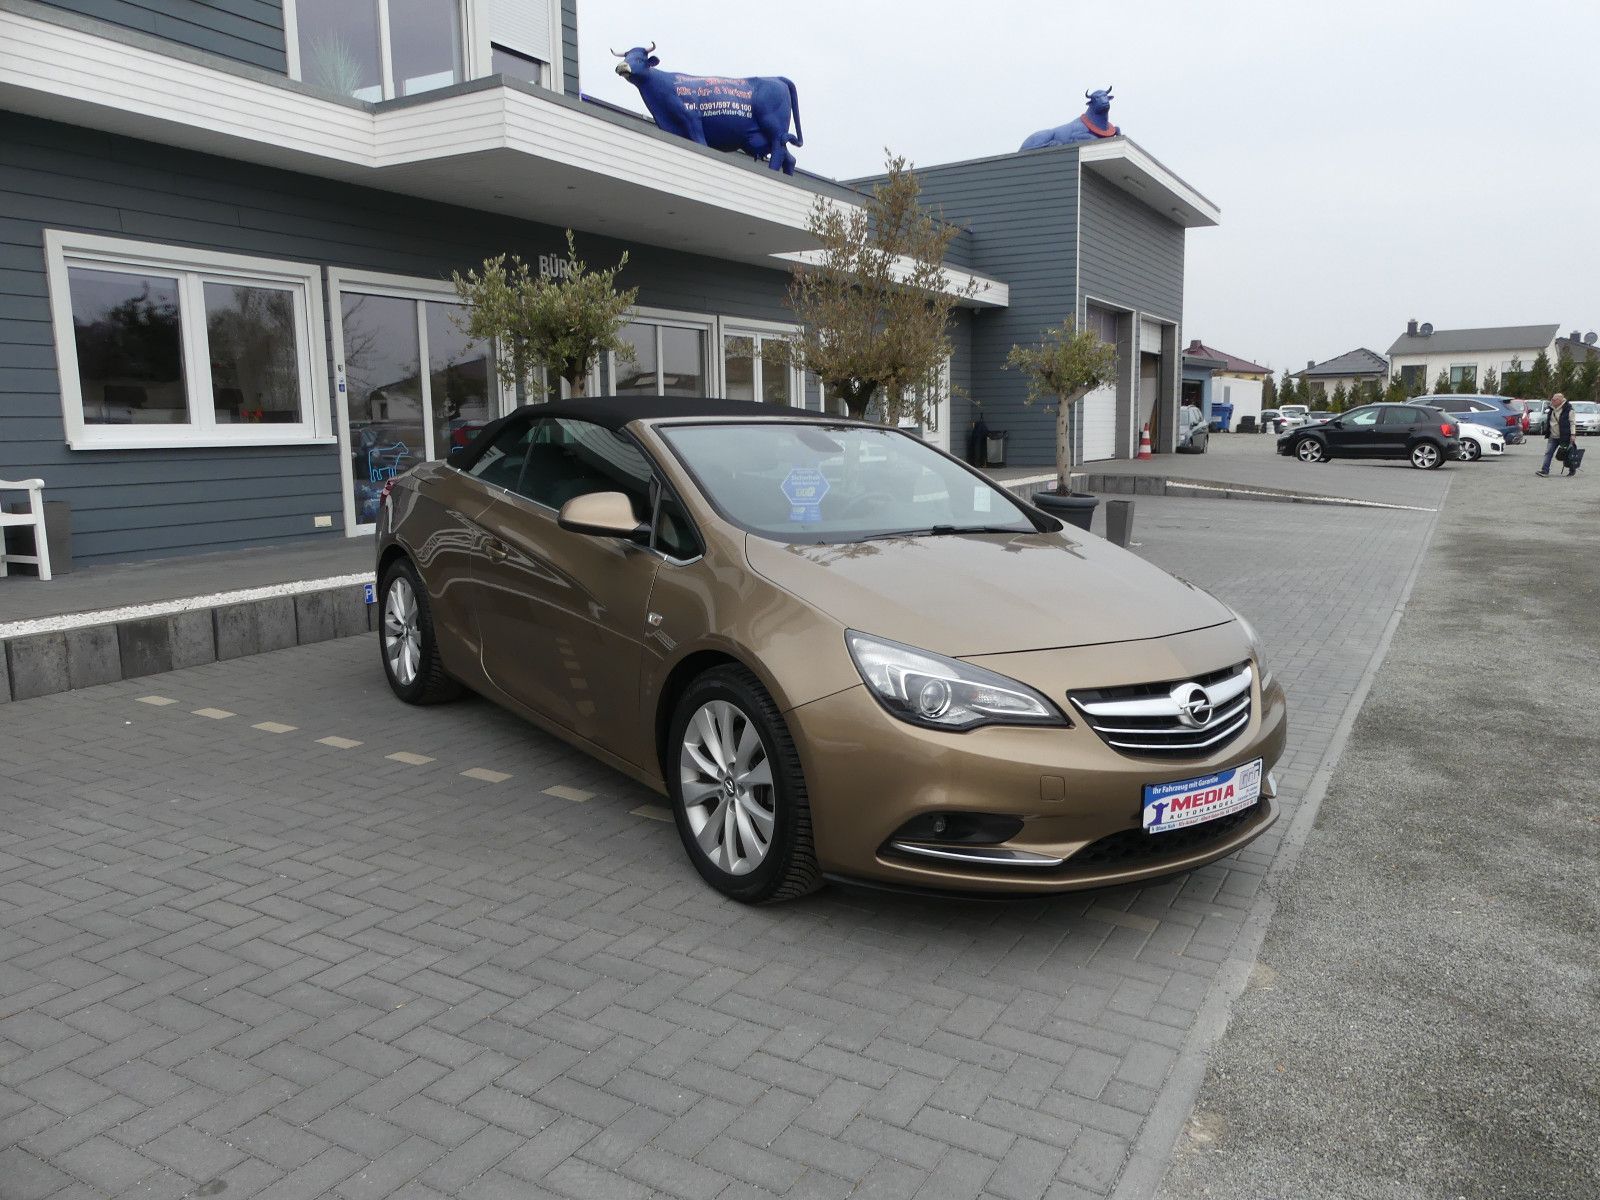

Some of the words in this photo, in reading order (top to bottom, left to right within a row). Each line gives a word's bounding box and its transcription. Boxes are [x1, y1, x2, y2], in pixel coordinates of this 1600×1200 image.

[684, 102, 698, 110] Tel.
[699, 101, 730, 111] 0391/597
[740, 103, 752, 112] 100
[1152, 785, 1161, 795] Ihr
[1162, 782, 1188, 794] Fahrzeug
[1188, 780, 1198, 789] mit
[1198, 776, 1219, 787] Garantie
[1170, 783, 1235, 813] MEDIA
[1169, 799, 1234, 820] AUTOHANDEL
